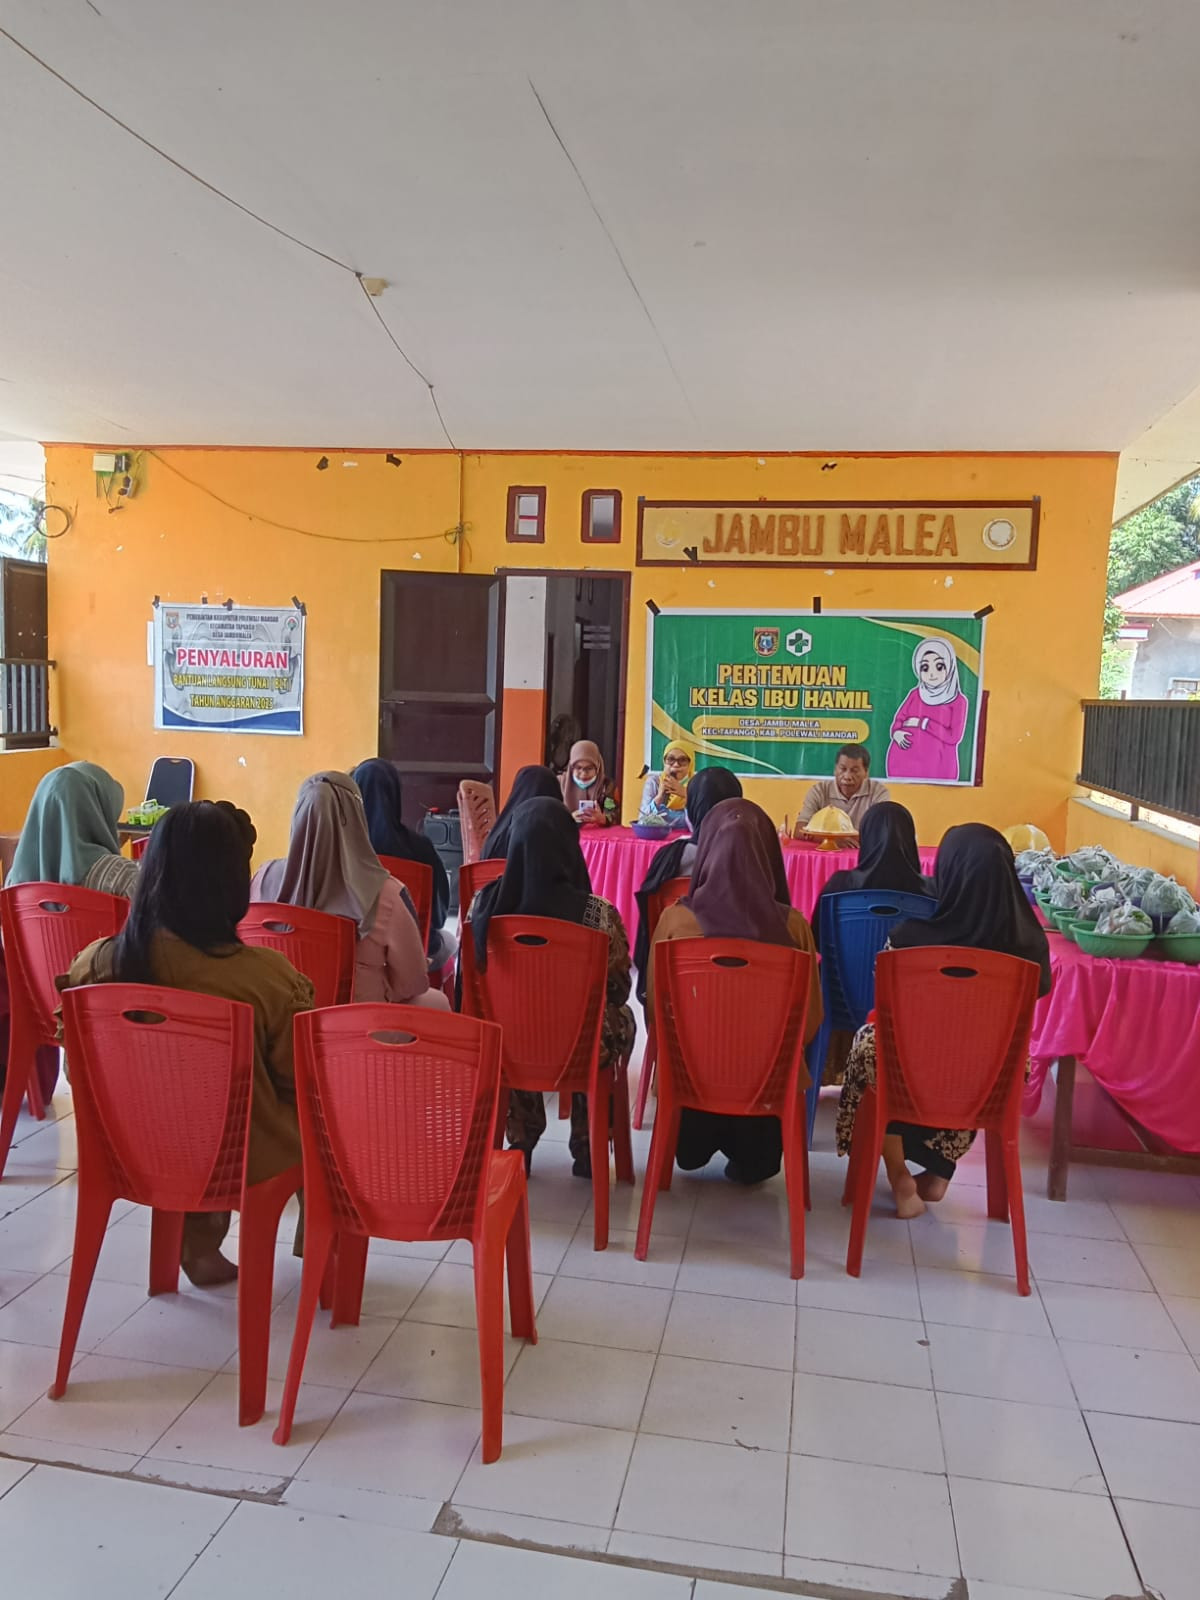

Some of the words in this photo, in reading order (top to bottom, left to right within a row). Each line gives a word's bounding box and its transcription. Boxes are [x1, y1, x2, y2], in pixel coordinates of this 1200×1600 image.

[702, 512, 825, 556] JAMBU
[839, 513, 959, 557] MALEA
[176, 647, 289, 670] PENYALURAN
[172, 673, 207, 688] BANTUAN
[207, 674, 247, 689] LANGSUNG
[247, 676, 270, 690] TUNAI
[717, 663, 847, 688] PERTEMUAN
[190, 693, 216, 708] TAHUN
[216, 695, 256, 709] ANGGARAN
[690, 687, 759, 709] KELAS
[762, 689, 799, 710] IBU
[802, 690, 873, 711] HAMIL
[739, 719, 760, 727] DESA
[761, 719, 791, 728] JAMBU
[791, 720, 820, 729] MALEA
[779, 729, 820, 738] POLEWALI
[821, 731, 858, 740] MANDAR
